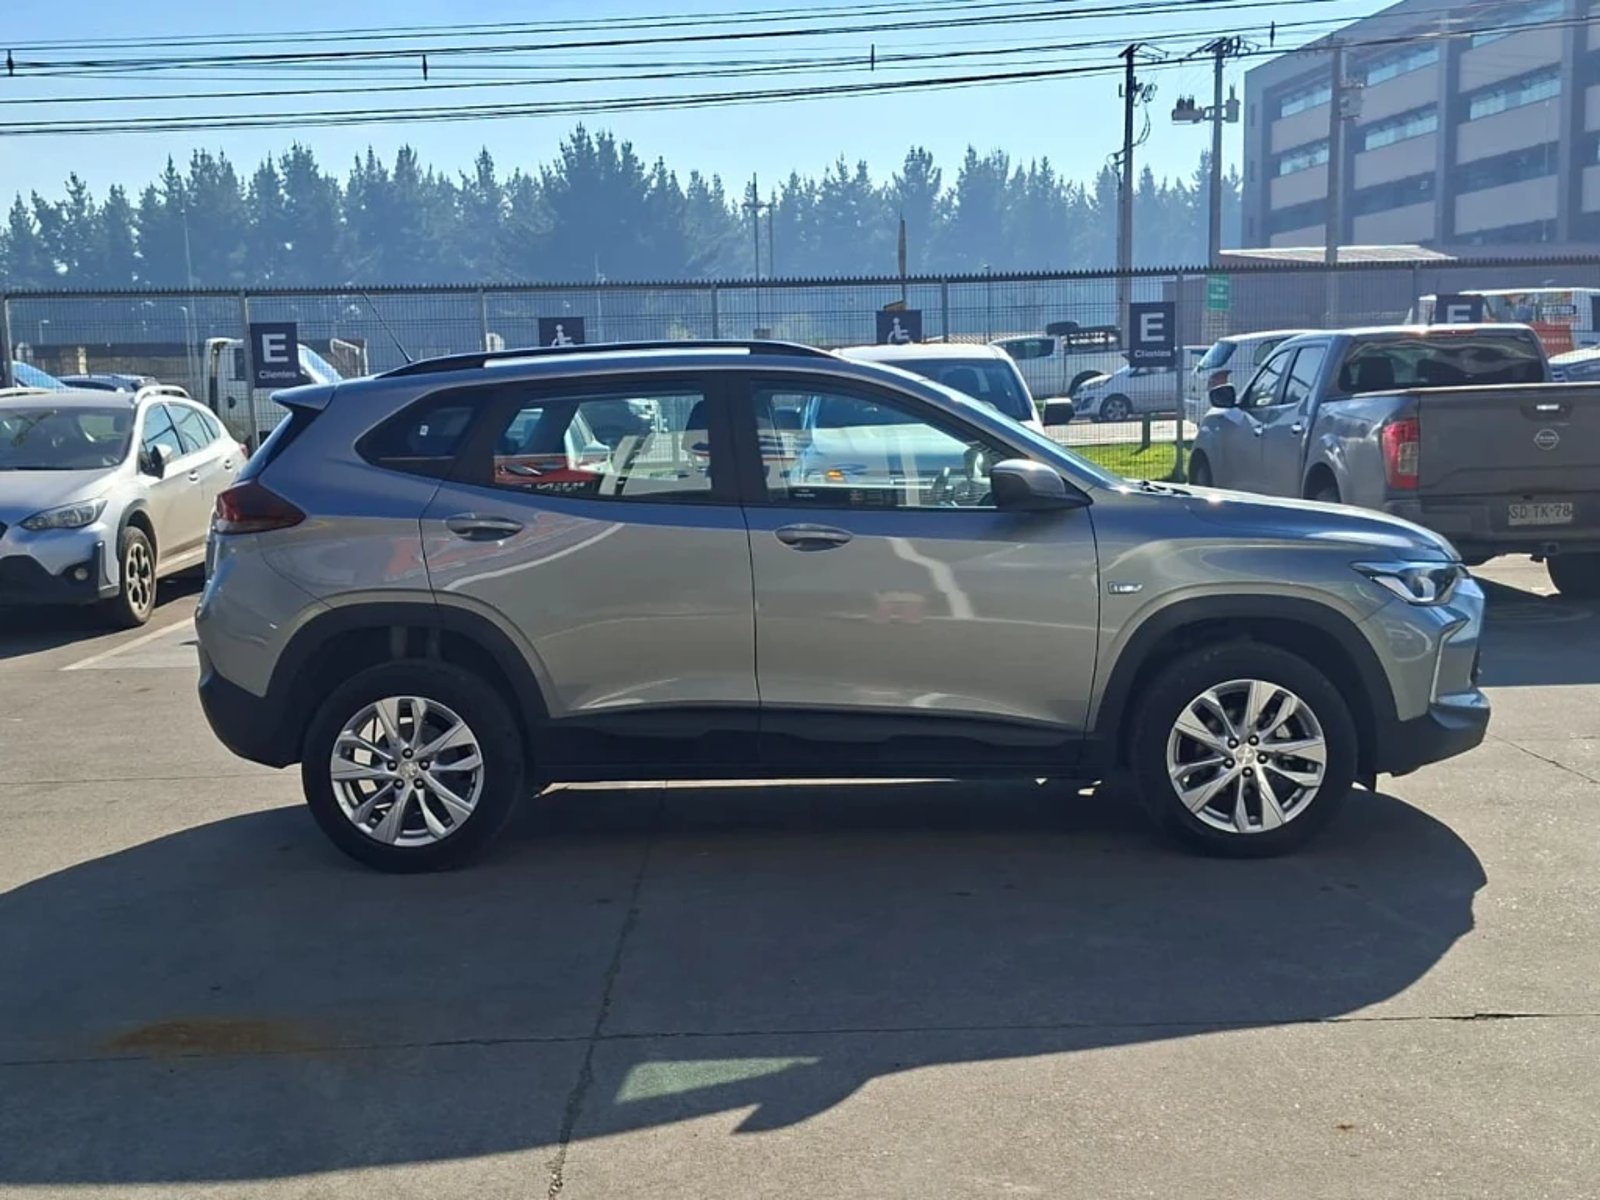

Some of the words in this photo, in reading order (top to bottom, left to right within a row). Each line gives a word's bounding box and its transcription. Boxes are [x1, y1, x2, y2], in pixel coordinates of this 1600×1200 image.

[1141, 312, 1165, 342] E
[262, 333, 289, 363] E
[259, 370, 297, 379] Clientes
